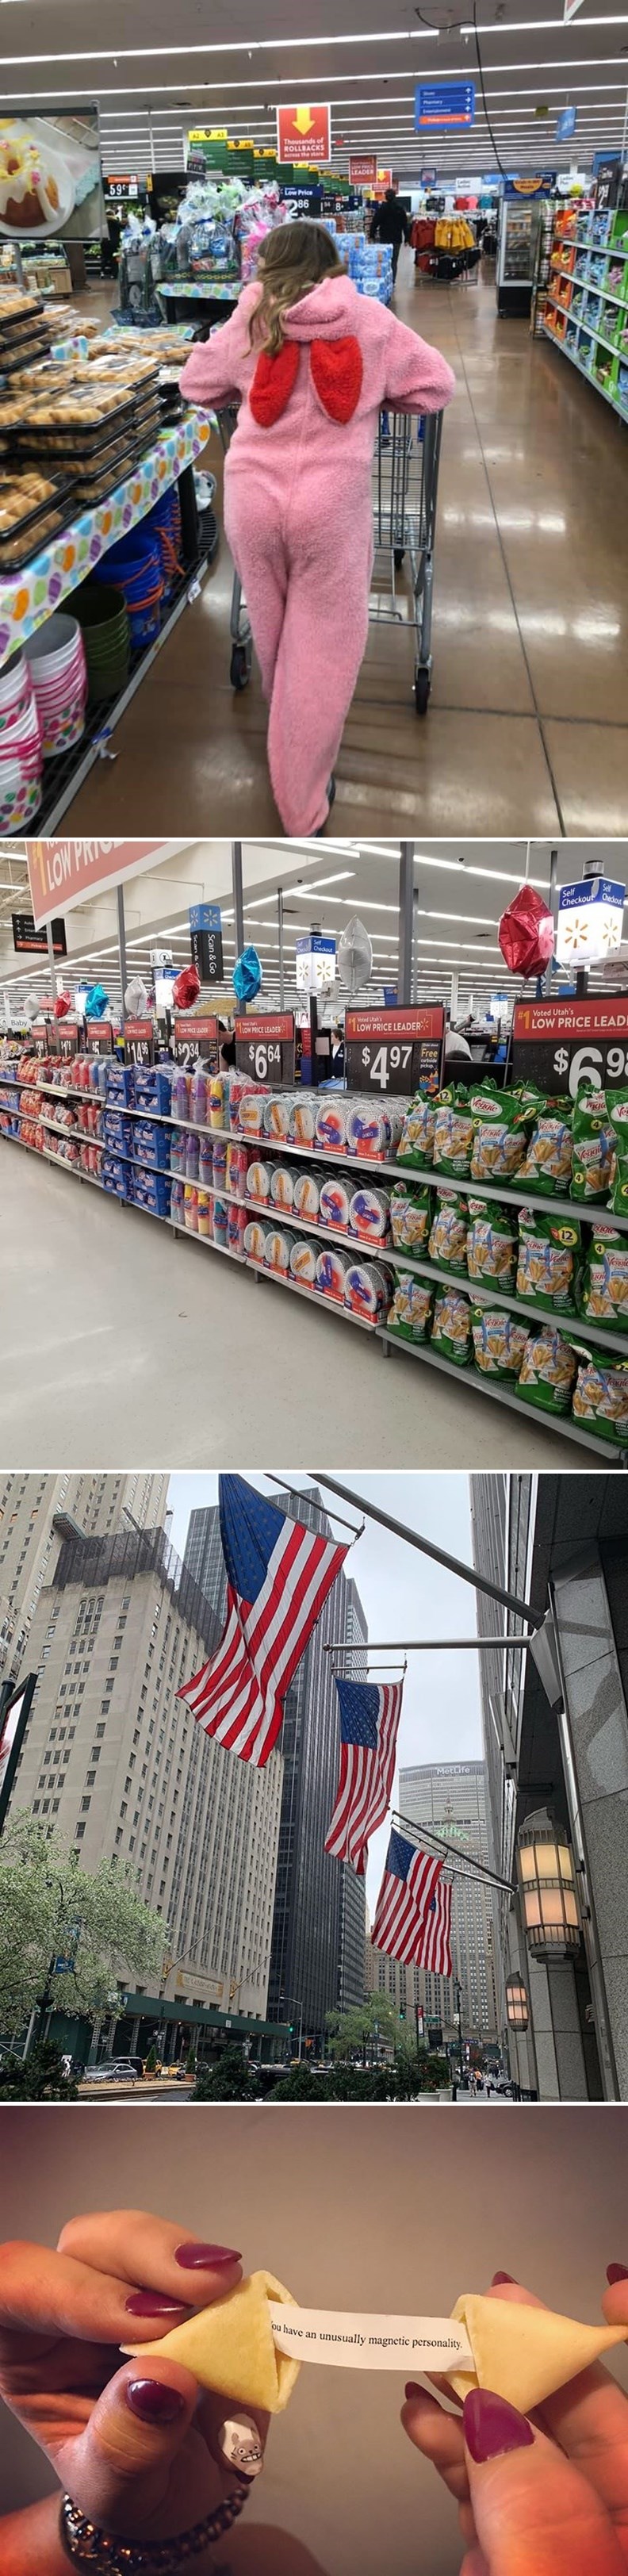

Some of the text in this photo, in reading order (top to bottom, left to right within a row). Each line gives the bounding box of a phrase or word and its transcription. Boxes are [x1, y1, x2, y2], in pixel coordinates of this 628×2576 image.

[47, 841, 71, 891] LOW
[562, 887, 576, 898] Self
[603, 884, 612, 893] Self
[561, 895, 595, 907] Checkout
[602, 893, 622, 906] Checkout
[209, 962, 217, 974] Go
[11, 1019, 28, 1029] Baby
[518, 1010, 530, 1029] #1
[532, 1018, 555, 1029] LOW
[557, 1016, 591, 1029] PRICE
[357, 1022, 422, 1032] LOW PRICE LEADER
[421, 1048, 438, 1058] Free
[438, 1091, 450, 1101] 12
[472, 1098, 499, 1112] Veggie
[561, 1230, 574, 1240] 12
[484, 1317, 507, 1328] Veggie
[435, 1765, 470, 1775] MetLife
[270, 2321, 281, 2332] ou
[283, 2324, 304, 2337] have
[320, 2333, 366, 2347] unusually
[368, 2336, 410, 2348] magnetic
[412, 2338, 462, 2351] personality.
